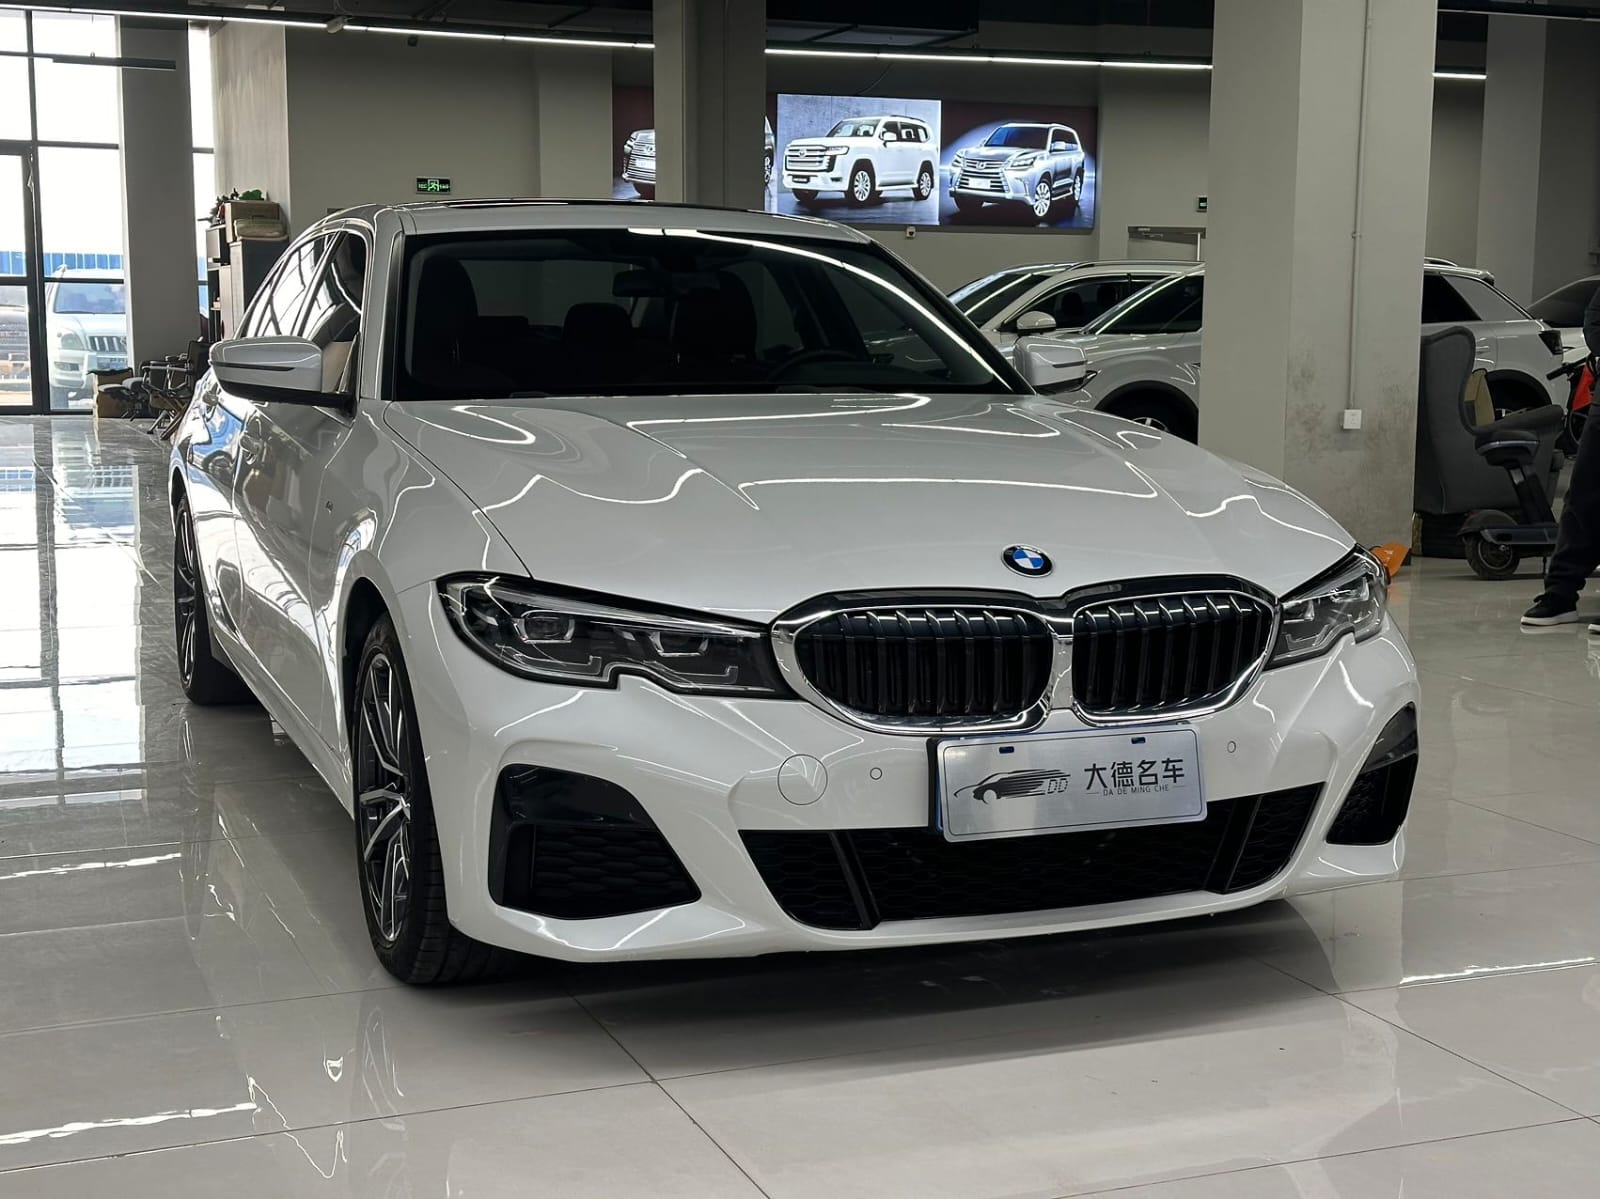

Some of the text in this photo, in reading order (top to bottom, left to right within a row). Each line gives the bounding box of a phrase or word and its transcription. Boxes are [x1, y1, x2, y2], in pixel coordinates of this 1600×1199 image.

[1084, 757, 1185, 791] 大德名车
[1103, 783, 1169, 797] DA DE MING CHE
